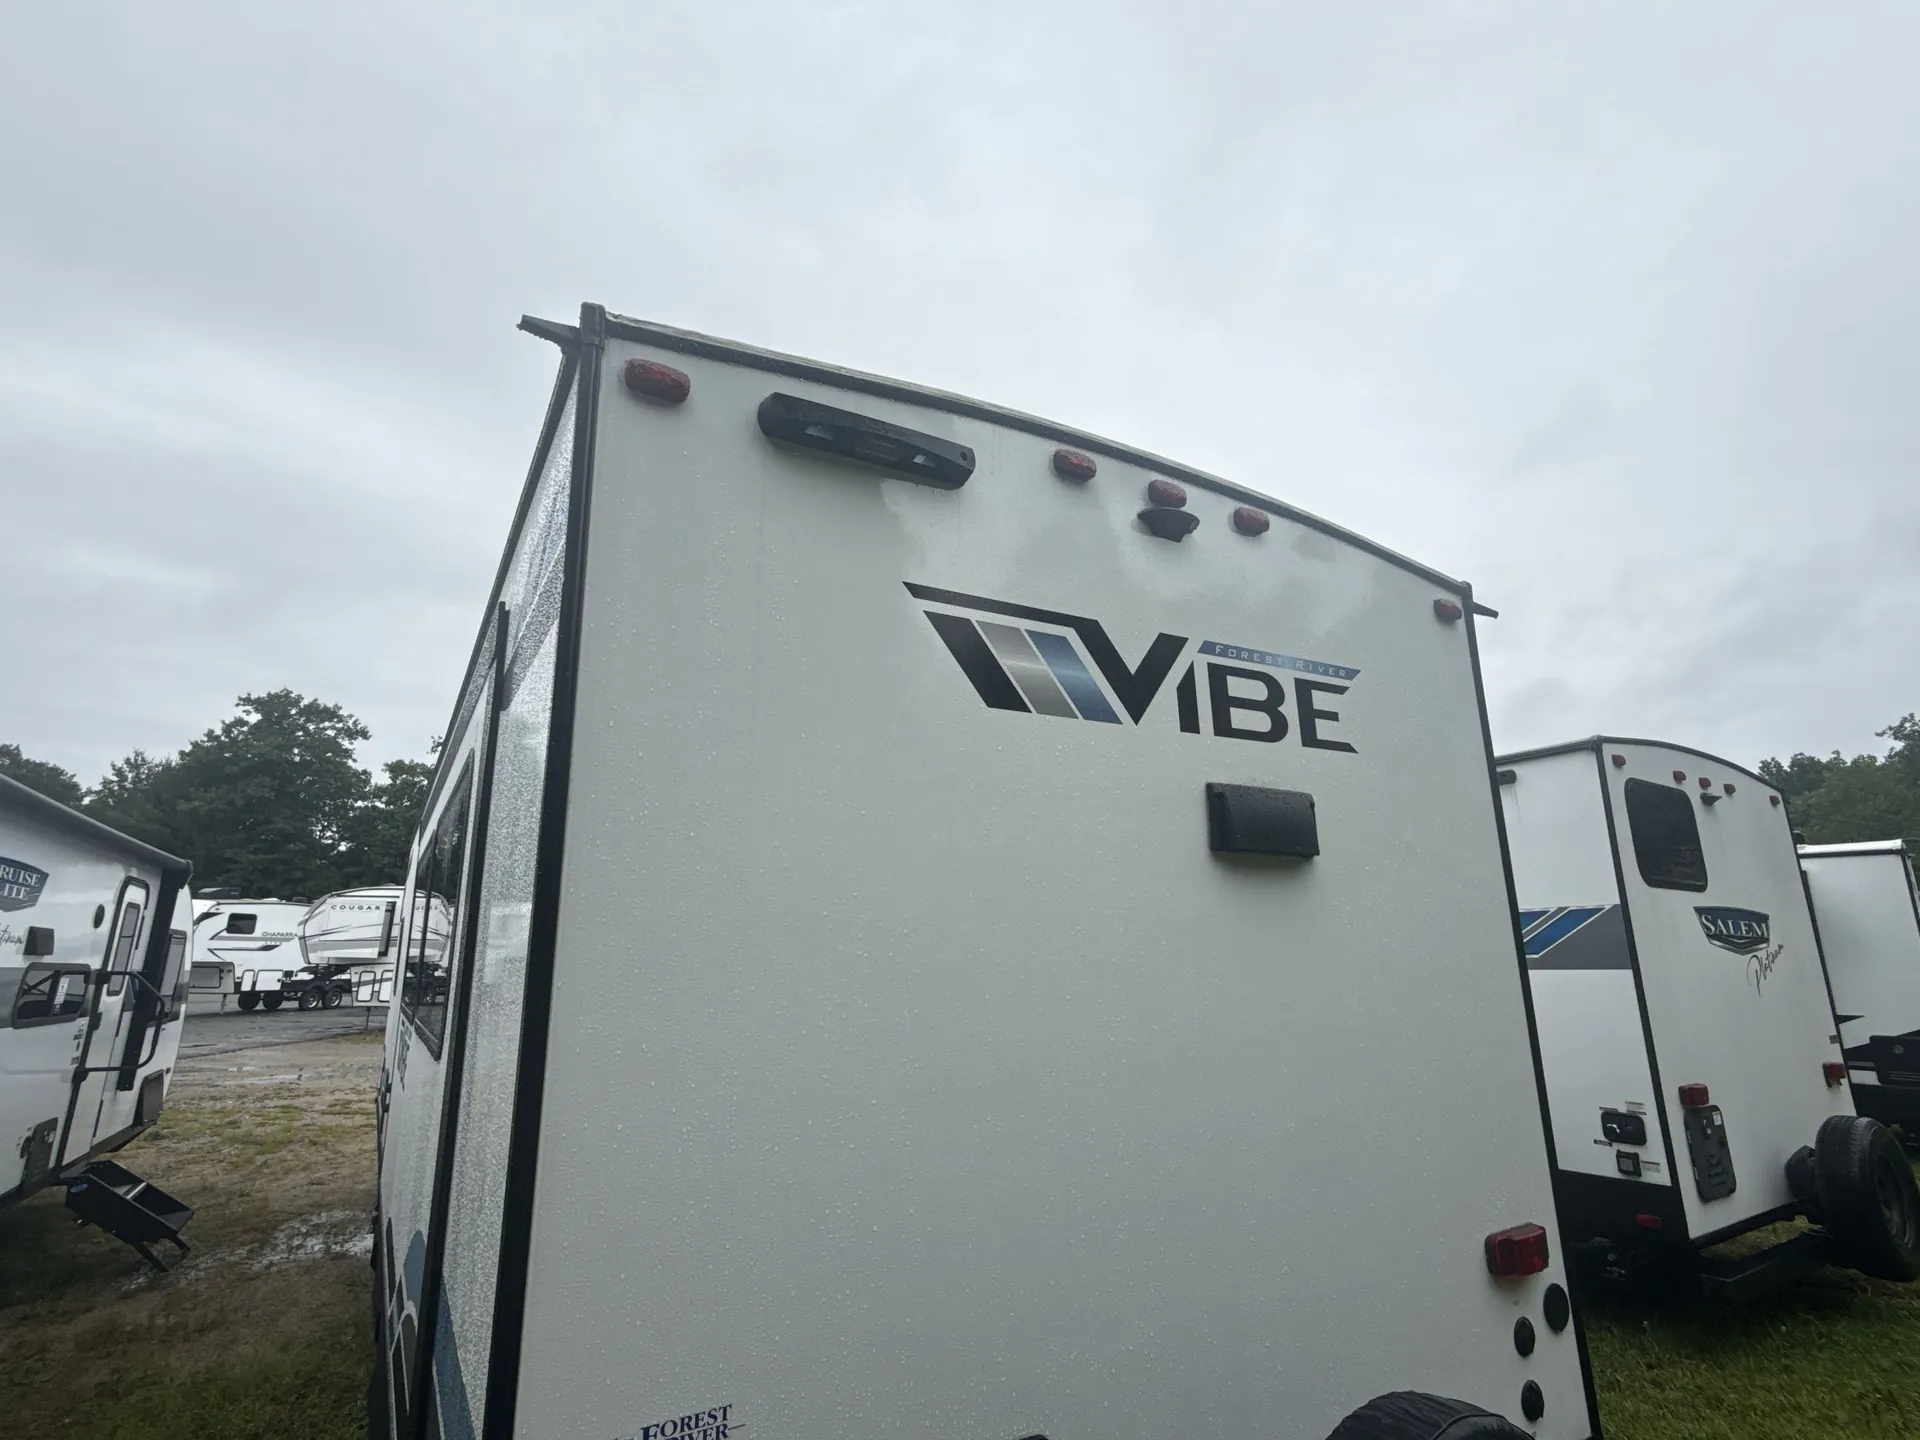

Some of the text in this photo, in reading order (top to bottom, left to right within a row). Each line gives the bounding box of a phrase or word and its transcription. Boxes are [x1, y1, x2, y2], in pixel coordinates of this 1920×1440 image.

[1215, 645, 1347, 678] FOREST RIVER
[1074, 619, 1360, 754] VIBE
[0, 864, 41, 888] RUISE
[0, 883, 30, 901] ITE
[1701, 914, 1769, 938] SALEM
[640, 1403, 733, 1440] FOREST
[664, 1423, 729, 1440] IVER
